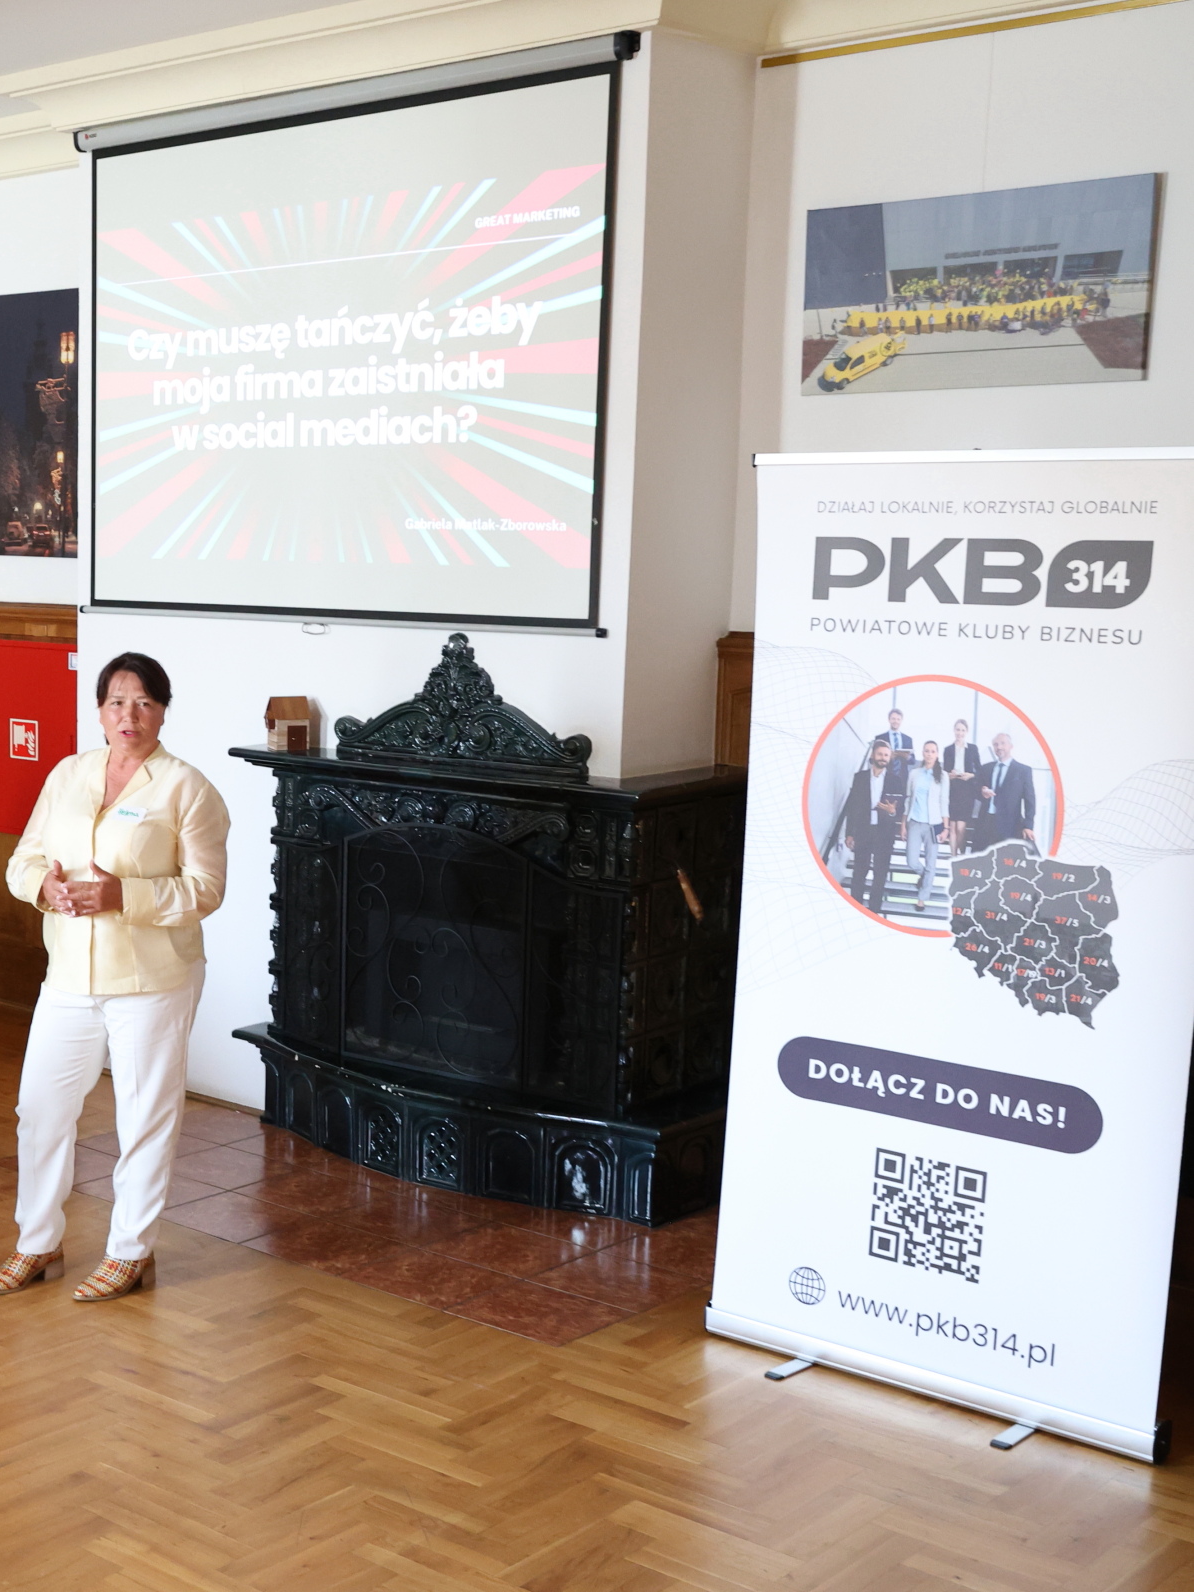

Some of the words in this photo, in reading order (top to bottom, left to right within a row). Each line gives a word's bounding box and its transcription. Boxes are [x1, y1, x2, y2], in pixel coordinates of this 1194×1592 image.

[474, 213, 511, 229] GREAT
[512, 205, 581, 225] MARKETING
[127, 328, 183, 370] Czy
[186, 322, 291, 359] muszę
[295, 298, 443, 354] tańczyć,
[448, 295, 543, 346] żeby
[153, 366, 231, 415] moja
[235, 363, 323, 401] firma
[328, 350, 505, 397] zaistniała
[171, 424, 200, 451] w
[202, 411, 295, 450] social
[300, 404, 478, 447] mediach?
[404, 517, 452, 530] Gabriela
[817, 500, 875, 514] DZIAŁAJ
[880, 500, 958, 516] LOKALNIE,
[963, 500, 1055, 514] KORZYSTAJ
[1061, 500, 1159, 515] GLOBALNIE
[812, 536, 1044, 606] PKB
[1064, 559, 1131, 594] 314
[810, 617, 948, 638] POWIATOWE
[958, 622, 1031, 641] KLUBY
[1040, 626, 1144, 646] BIZNESU
[1083, 956, 1108, 967] 20/4
[808, 1058, 925, 1100] DOŁĄCZ
[935, 1083, 979, 1110] DO
[989, 1094, 1067, 1129] NAS!
[838, 1289, 1056, 1368] www.pkb314.pl
